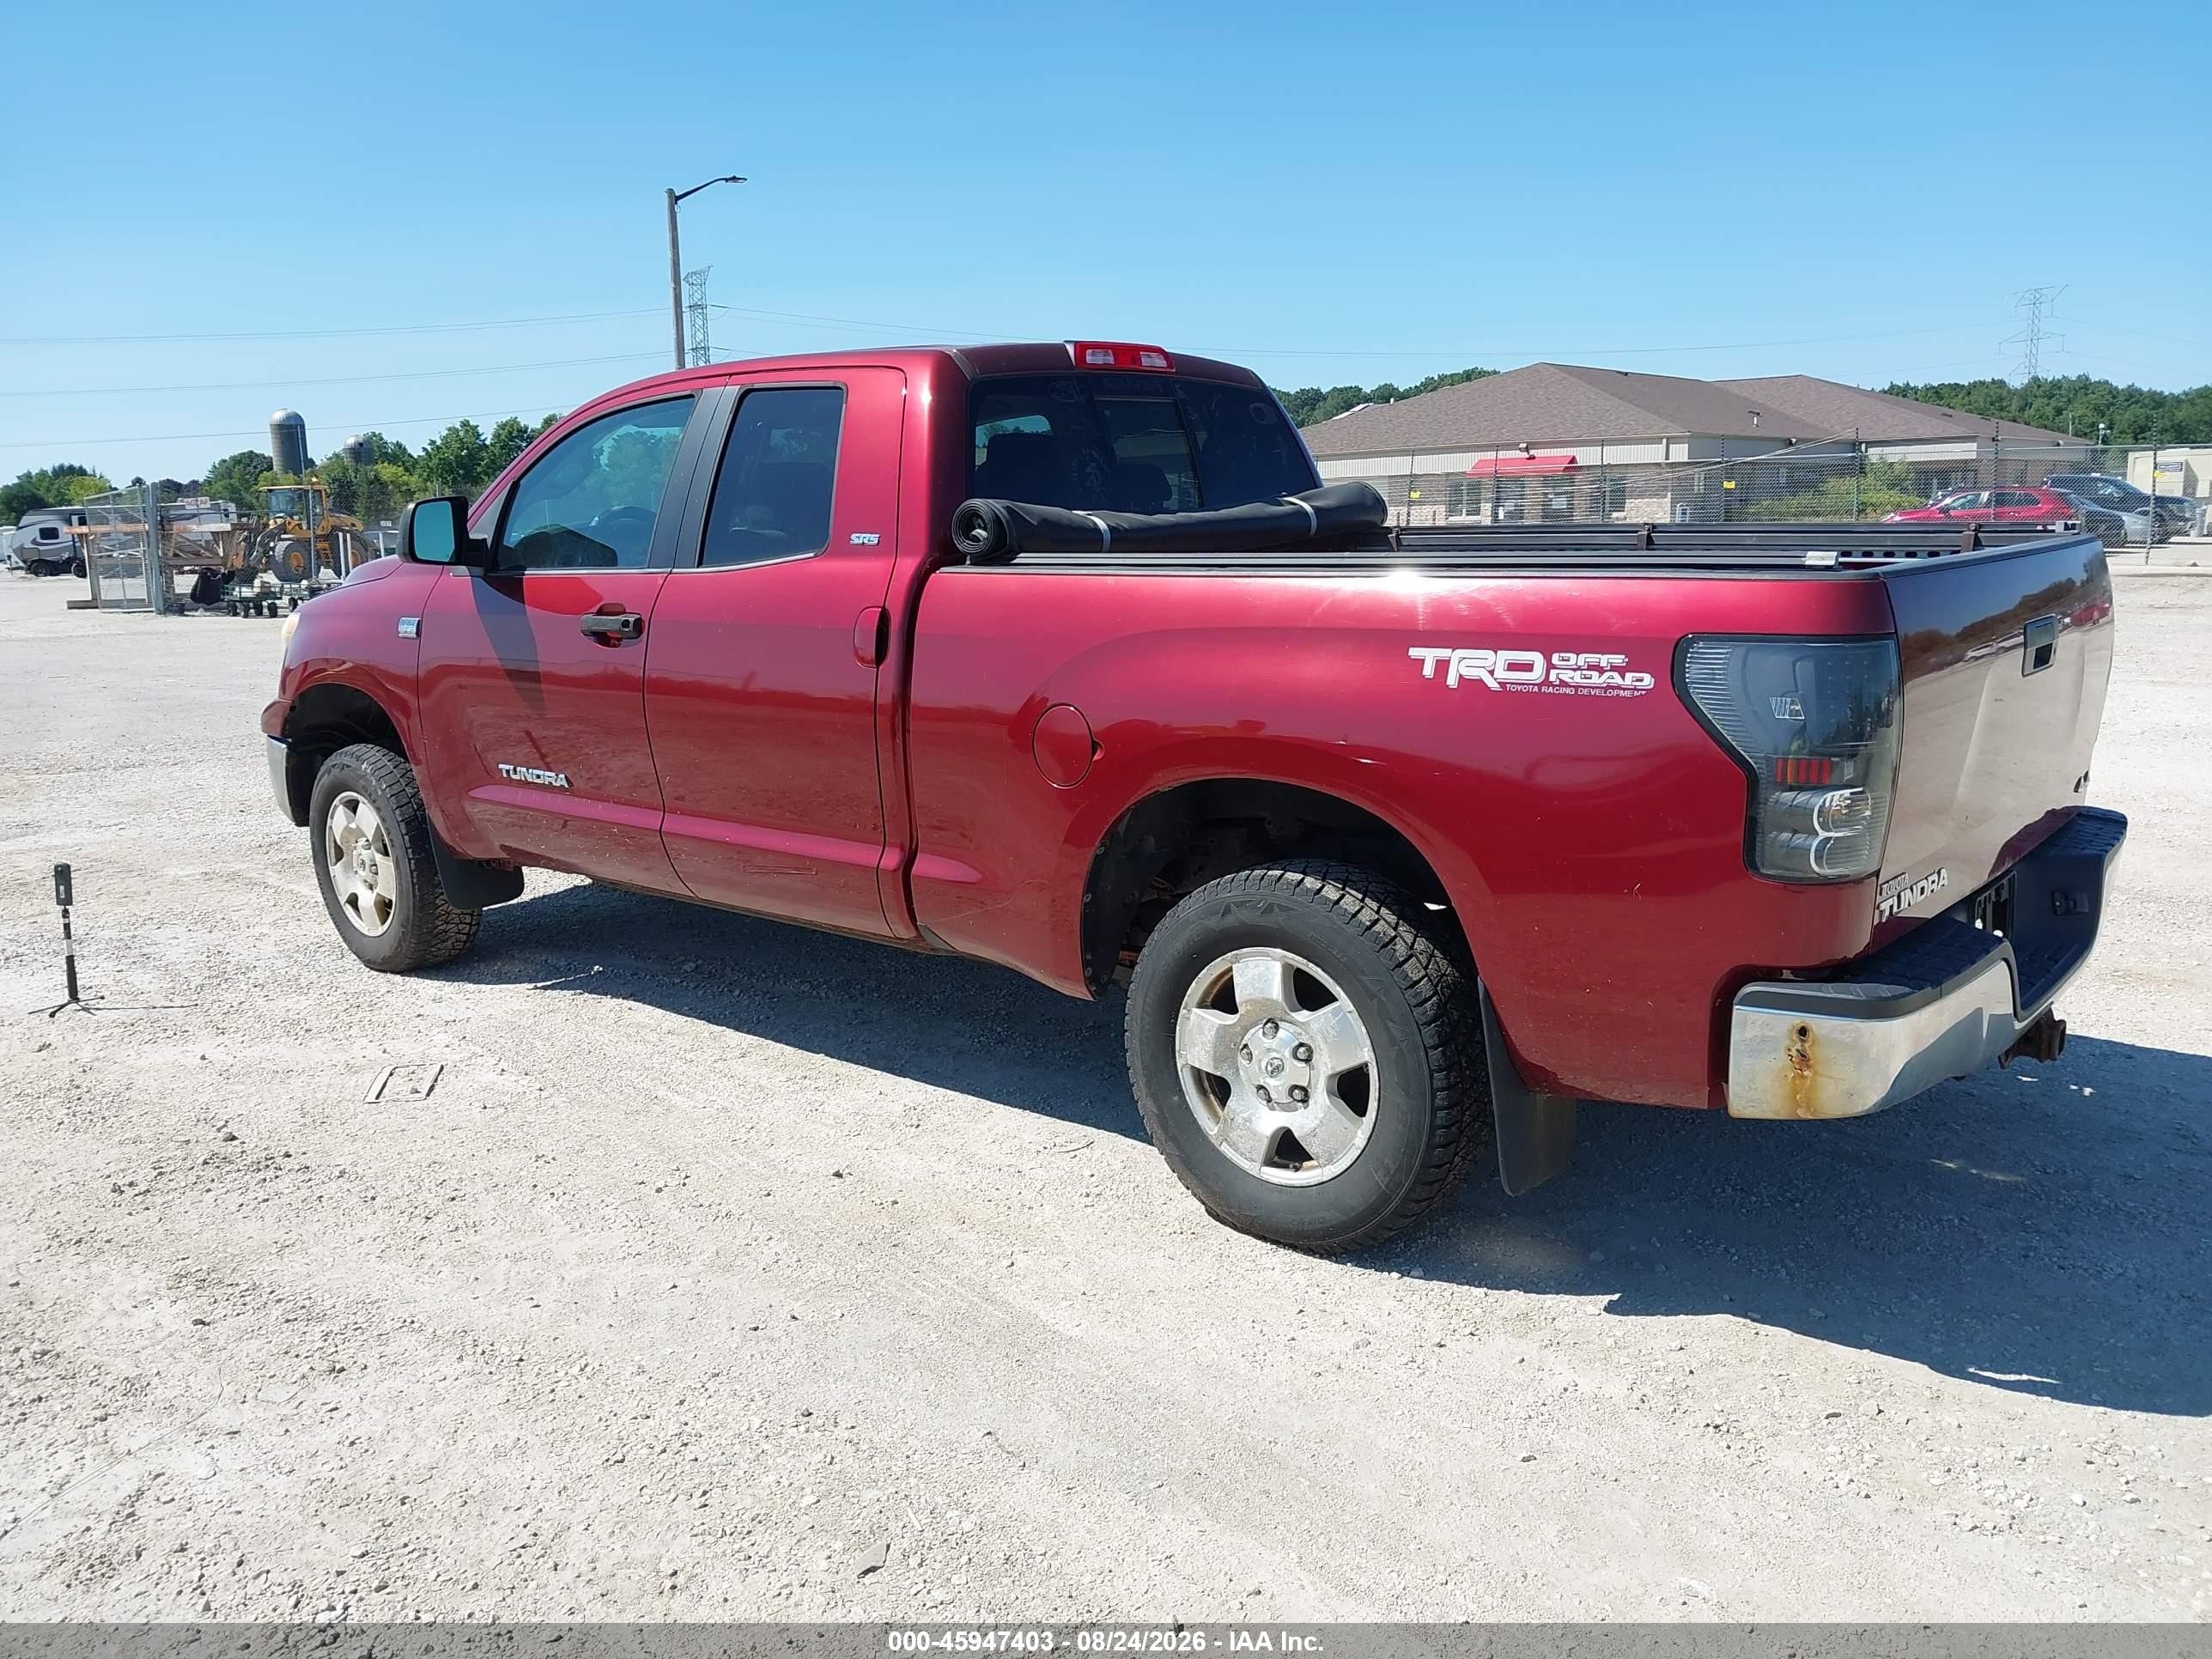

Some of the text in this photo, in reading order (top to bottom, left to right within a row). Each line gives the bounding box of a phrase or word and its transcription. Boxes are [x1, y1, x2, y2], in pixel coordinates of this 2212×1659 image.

[1407, 646, 1547, 691] TRD
[1551, 652, 1629, 671] OFF
[1505, 684, 1539, 693] TOYOTA
[1541, 685, 1576, 696] RACING
[1548, 668, 1656, 690] ROAD
[497, 763, 570, 789] TUNDRA
[1878, 867, 1949, 923] TUNDRA
[1881, 872, 1910, 896] TOYOTA
